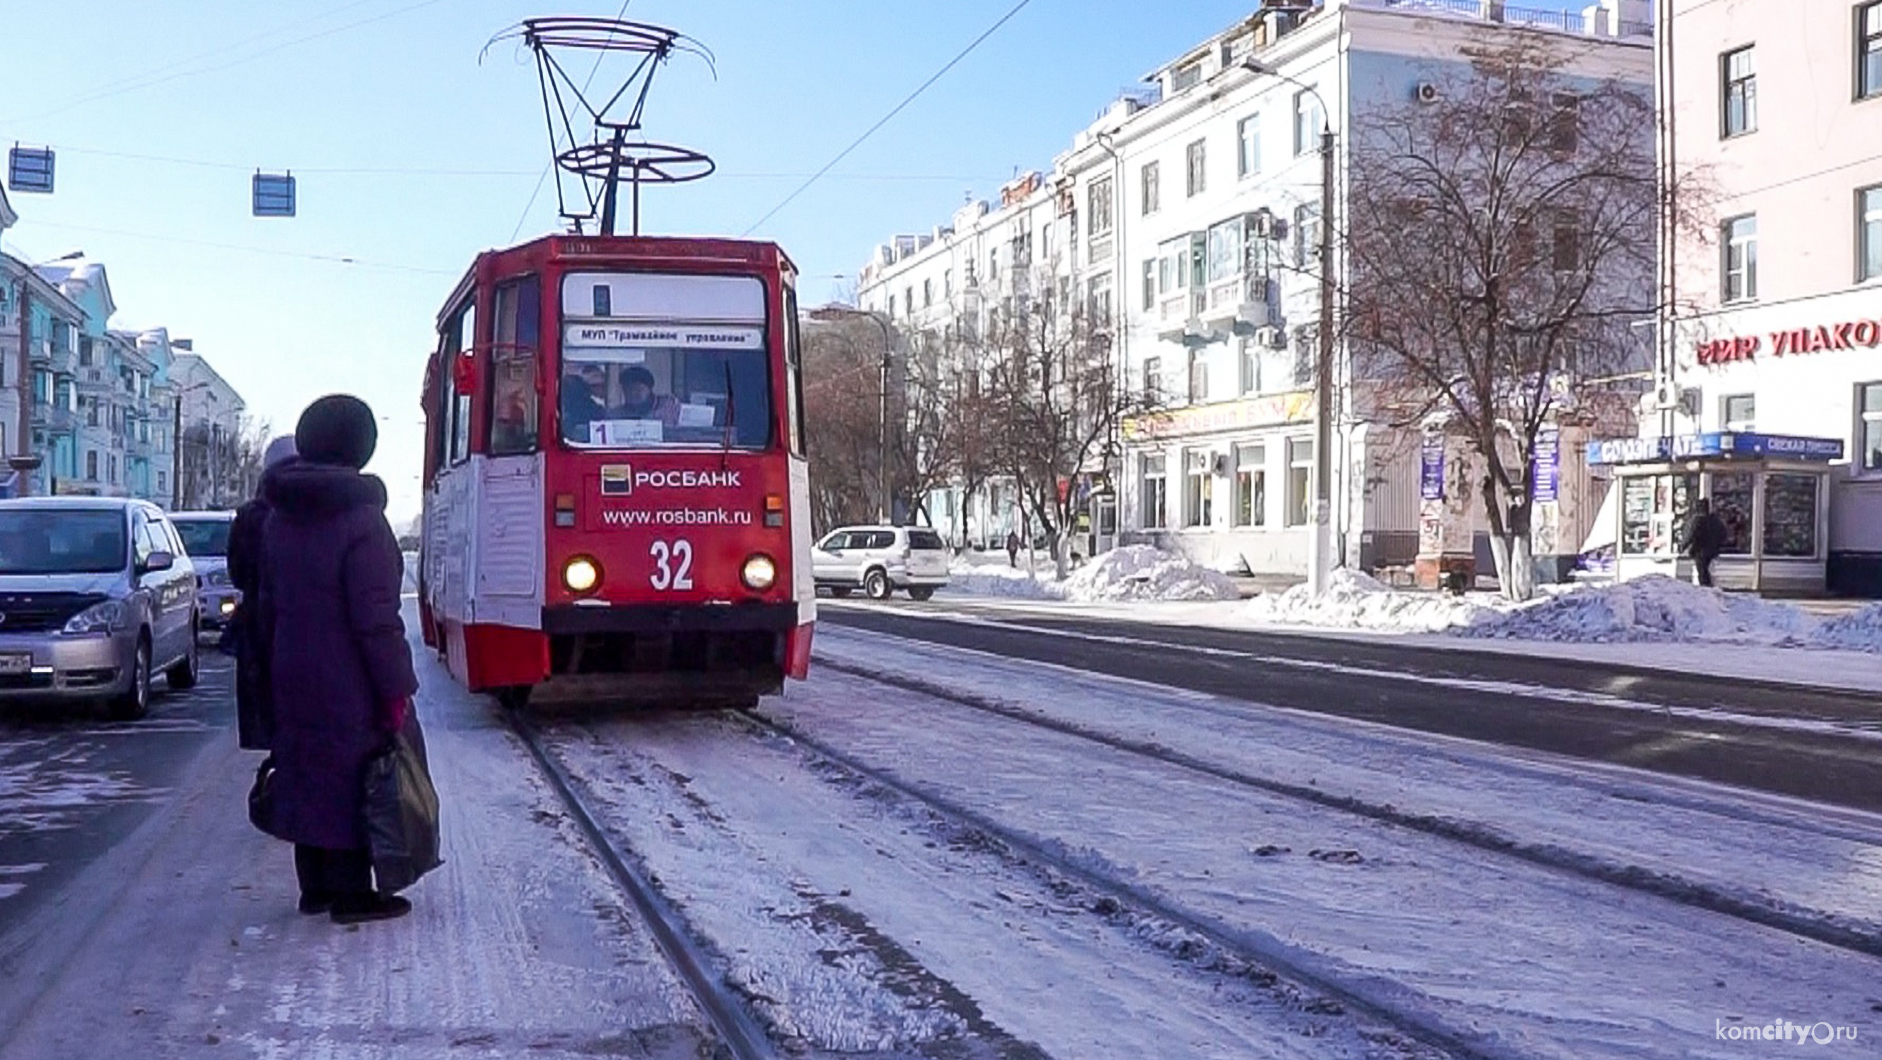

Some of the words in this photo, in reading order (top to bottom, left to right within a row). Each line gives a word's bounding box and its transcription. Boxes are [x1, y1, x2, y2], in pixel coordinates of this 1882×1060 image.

[581, 329, 606, 340] МУП
[1697, 336, 1760, 366] МИР
[1770, 319, 1882, 358] УПАКО
[595, 423, 607, 445] 1
[635, 471, 742, 488] РОСБАНК
[603, 507, 751, 525] www.rosbank.ru
[650, 540, 693, 590] 32
